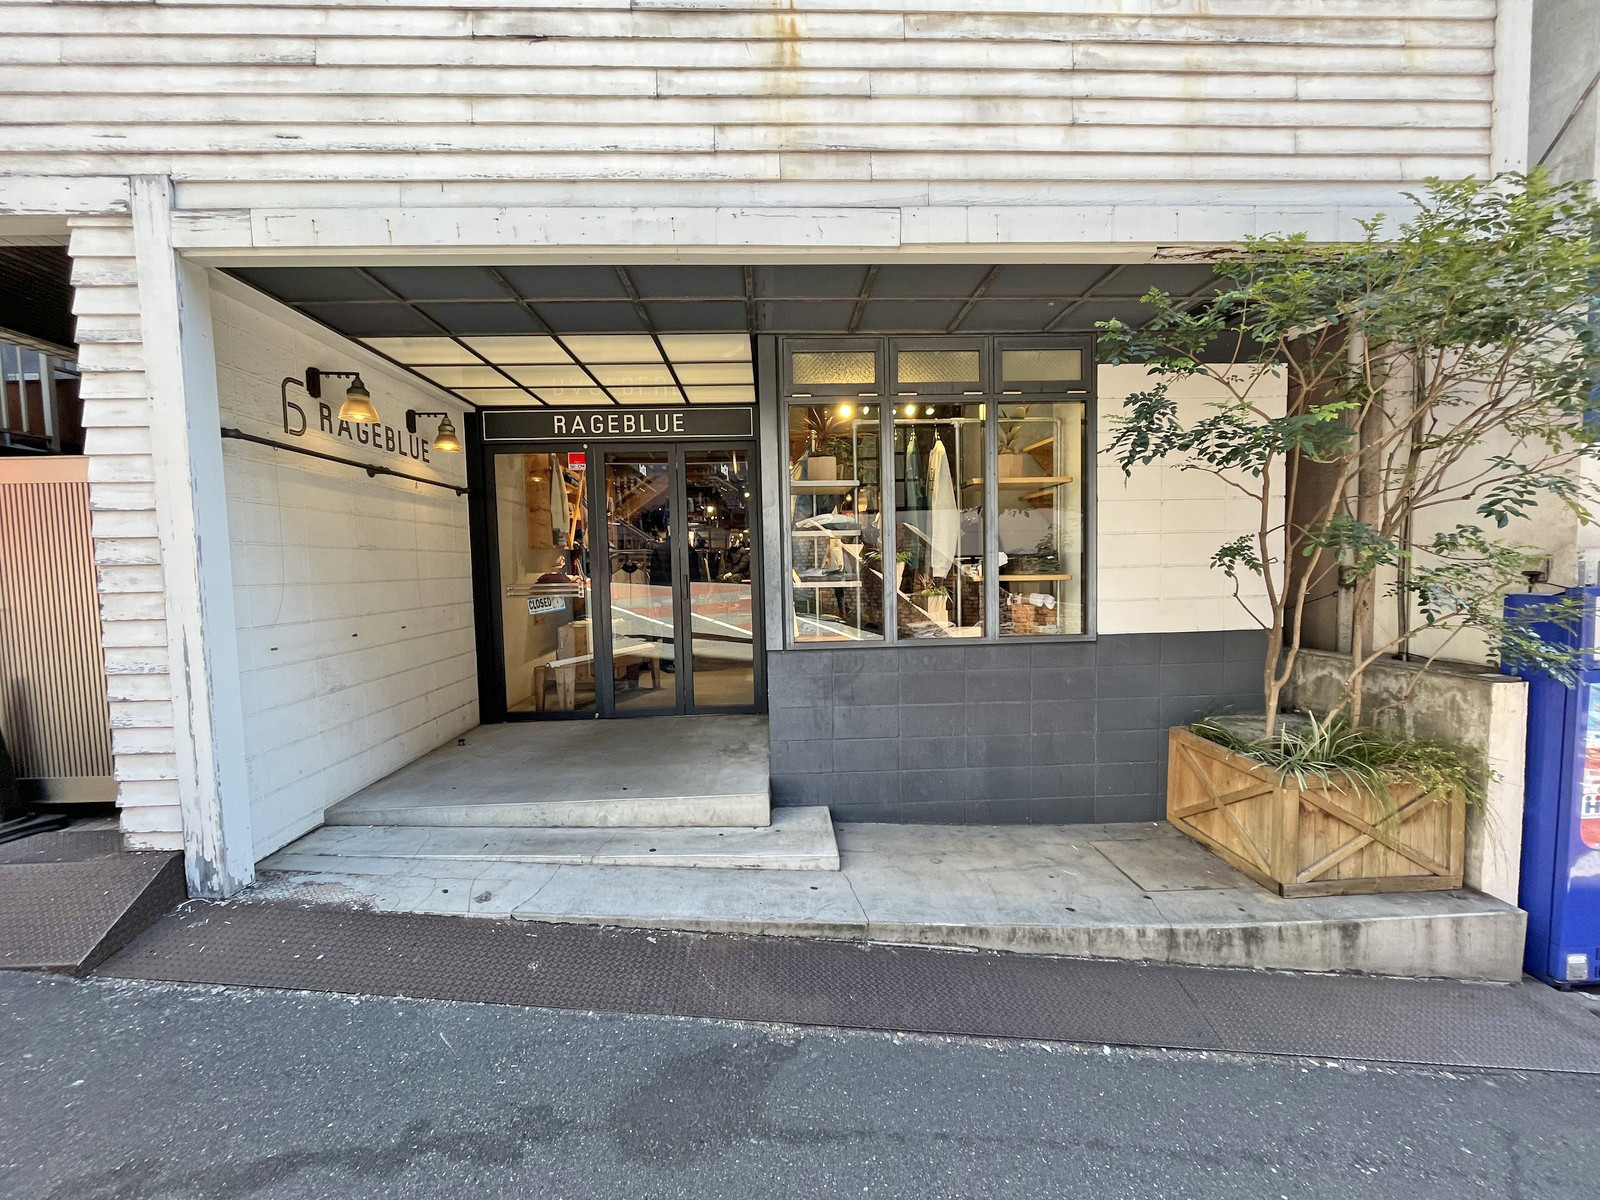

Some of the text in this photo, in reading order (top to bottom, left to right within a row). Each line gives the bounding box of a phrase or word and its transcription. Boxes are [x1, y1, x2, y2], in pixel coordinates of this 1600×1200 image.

[319, 402, 430, 463] RAGEBLUE
[553, 413, 685, 434] RAGEBLUE
[529, 597, 551, 610] CLOSED
